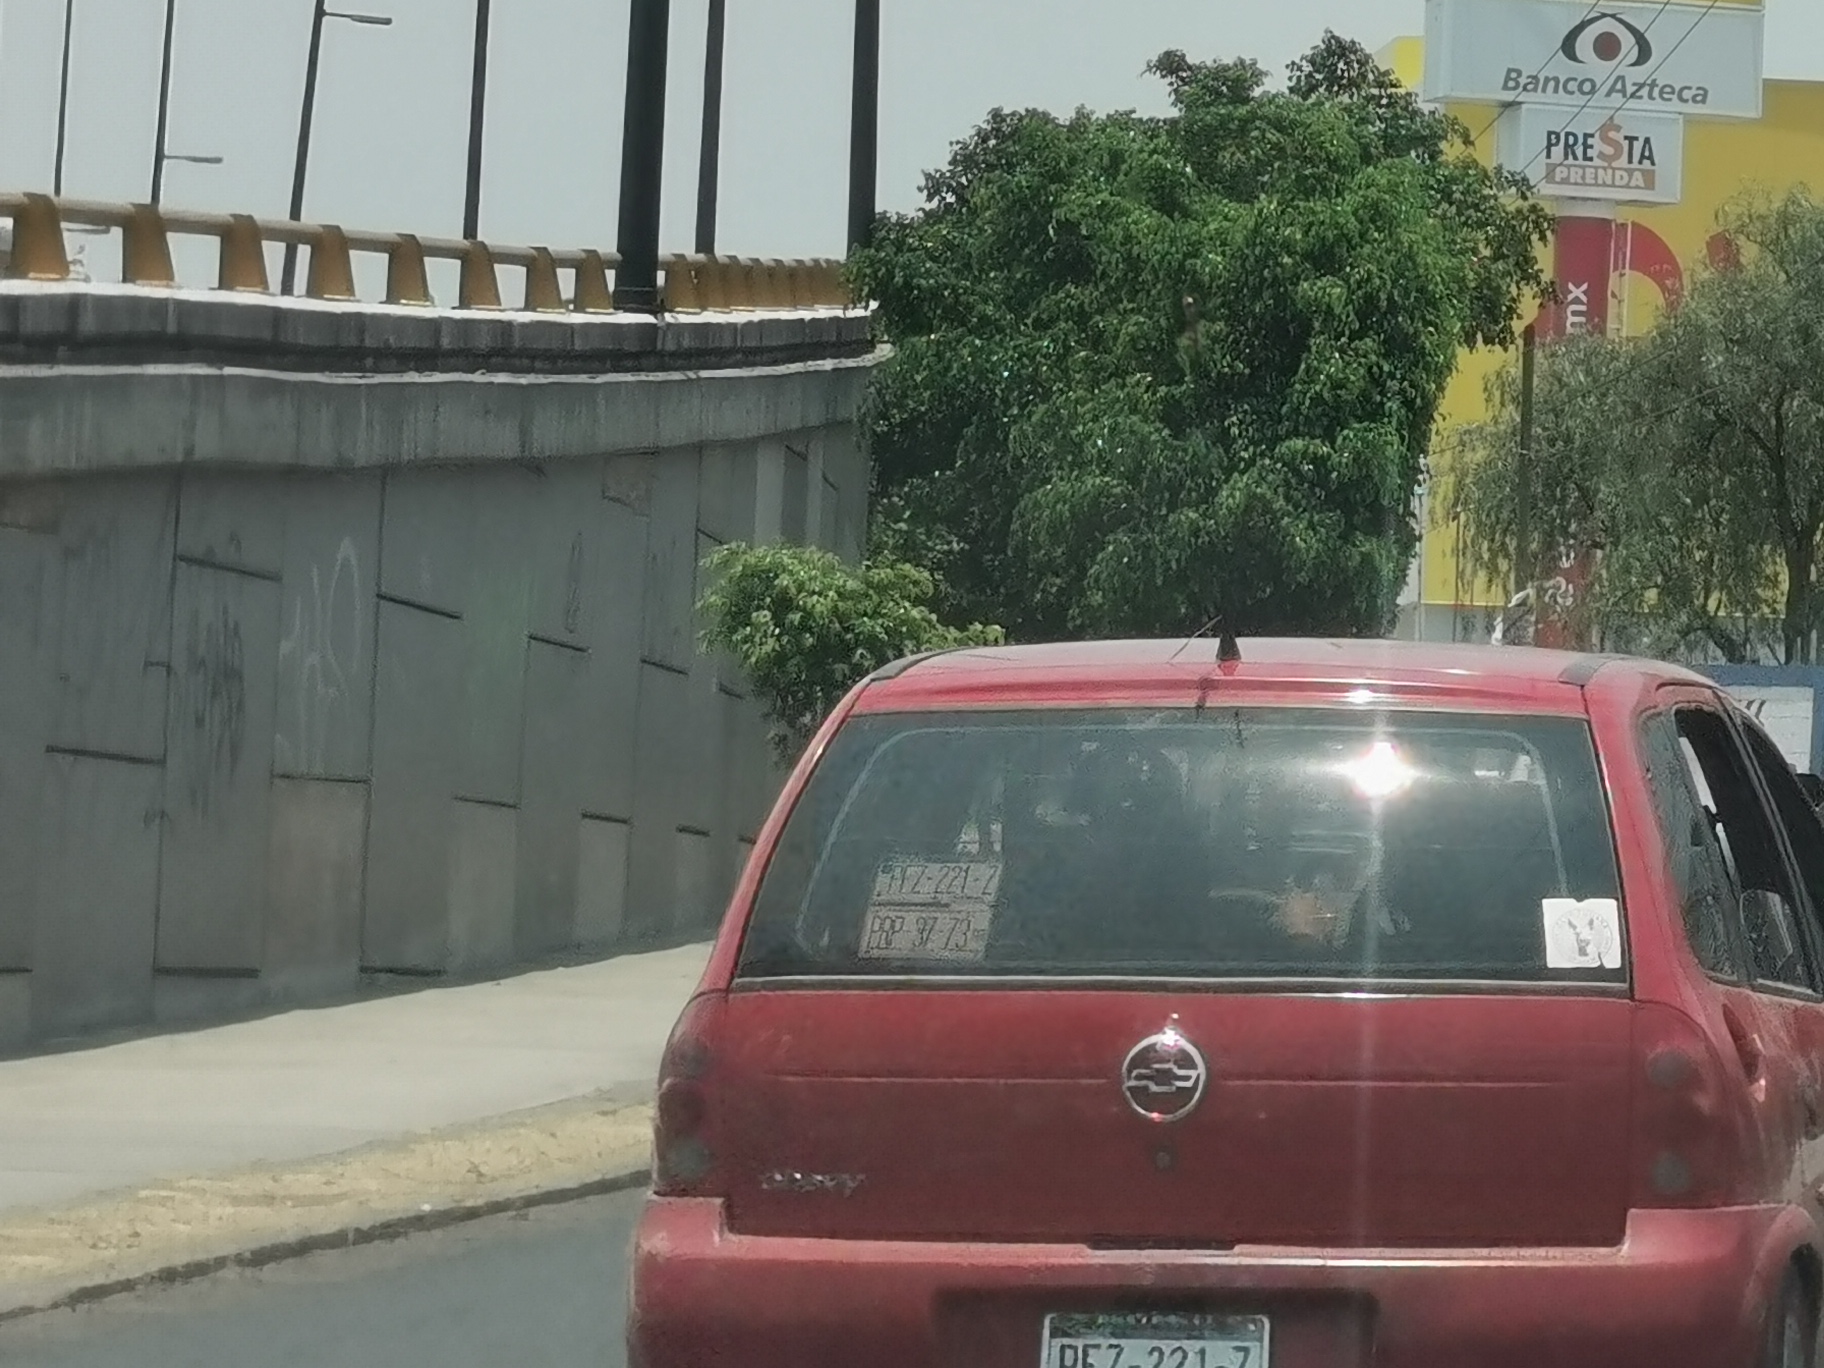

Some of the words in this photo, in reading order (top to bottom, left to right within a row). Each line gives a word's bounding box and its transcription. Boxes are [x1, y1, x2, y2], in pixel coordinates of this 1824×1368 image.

[1500, 66, 1599, 97] Banco
[1603, 74, 1710, 106] Azteca
[1554, 166, 1646, 188] PRENDA
